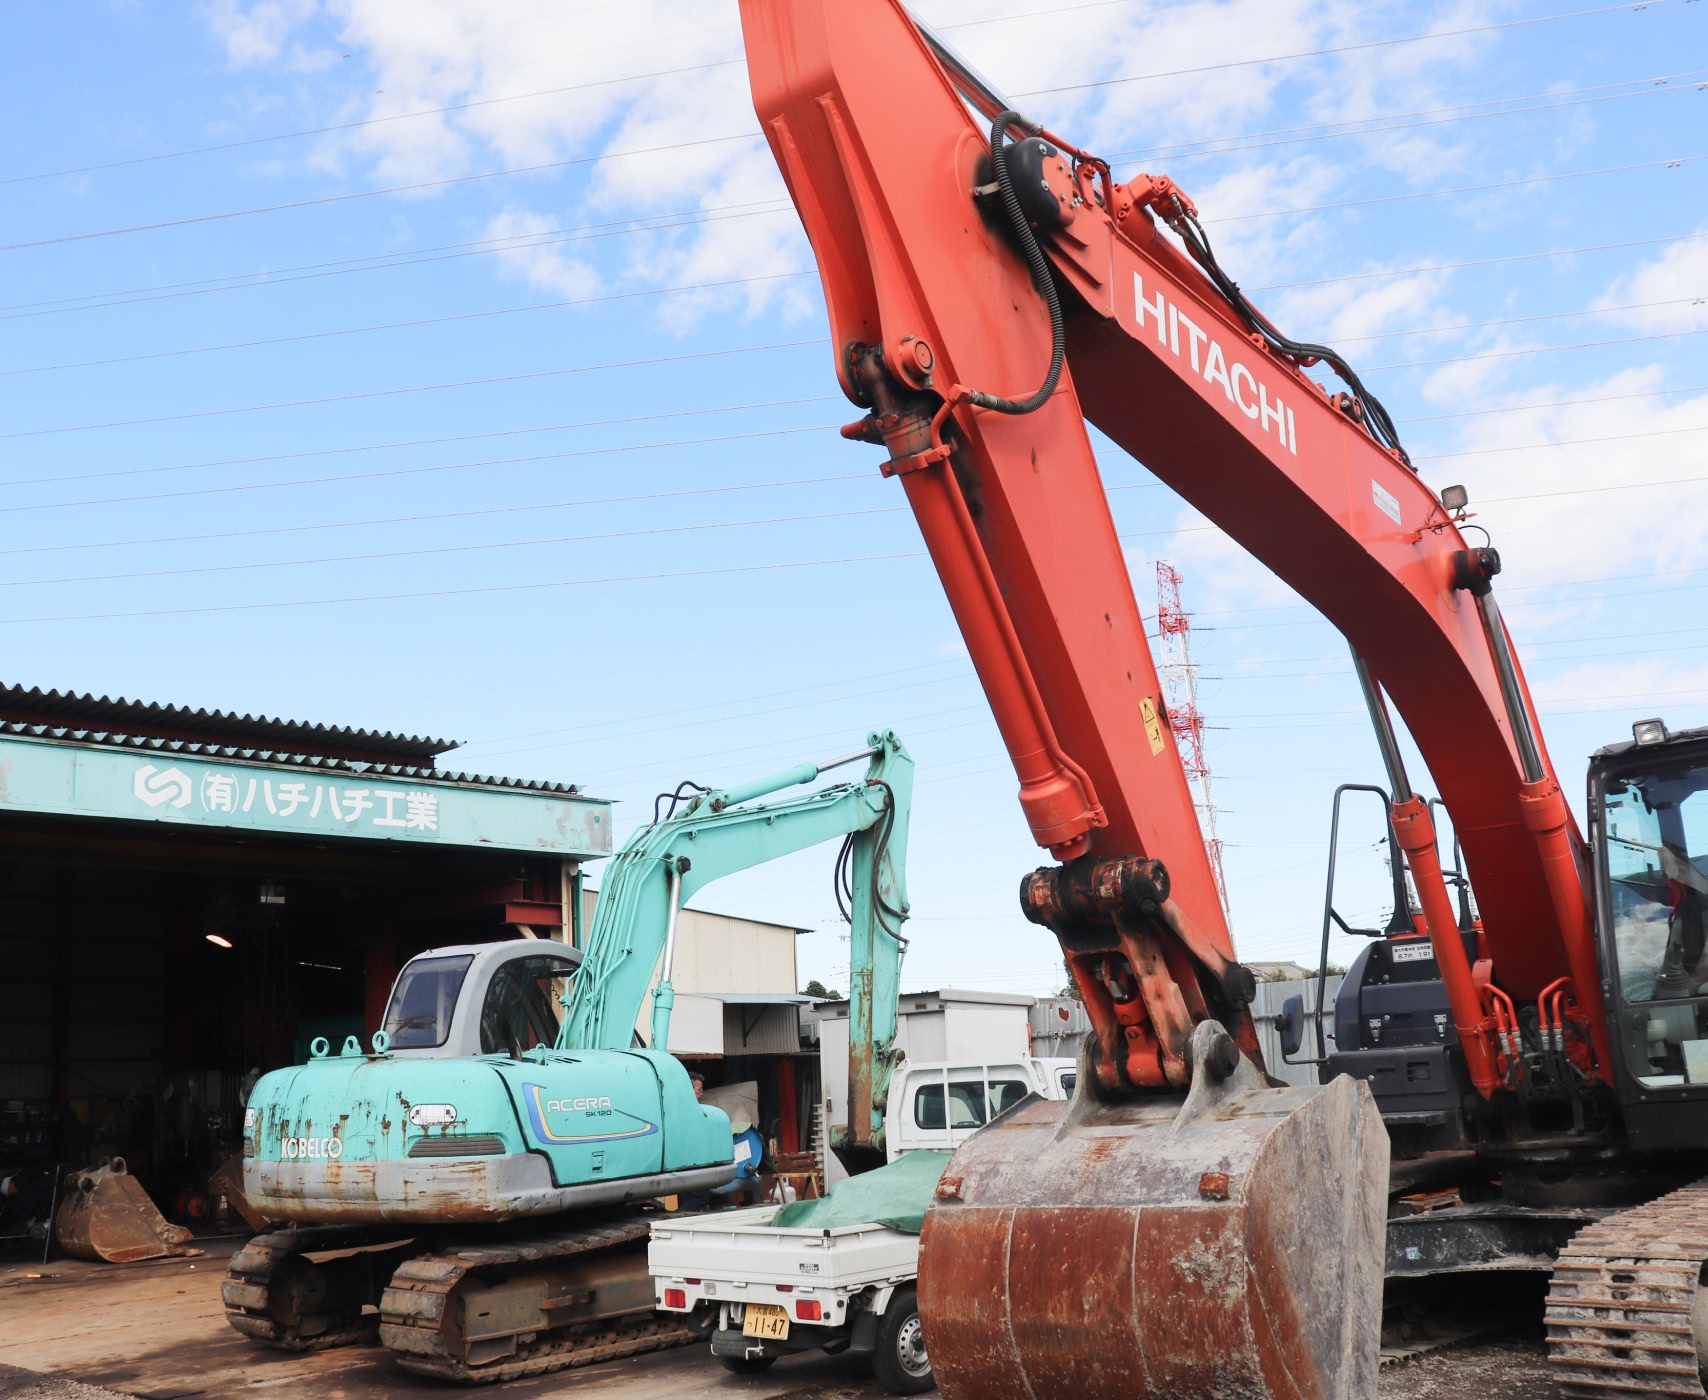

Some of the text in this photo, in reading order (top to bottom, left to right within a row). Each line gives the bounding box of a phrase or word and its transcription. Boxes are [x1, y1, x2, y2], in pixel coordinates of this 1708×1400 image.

[1133, 270, 1298, 456] HITACHI
[547, 1096, 611, 1113] ACERA
[281, 1136, 343, 1159] KOBELCO
